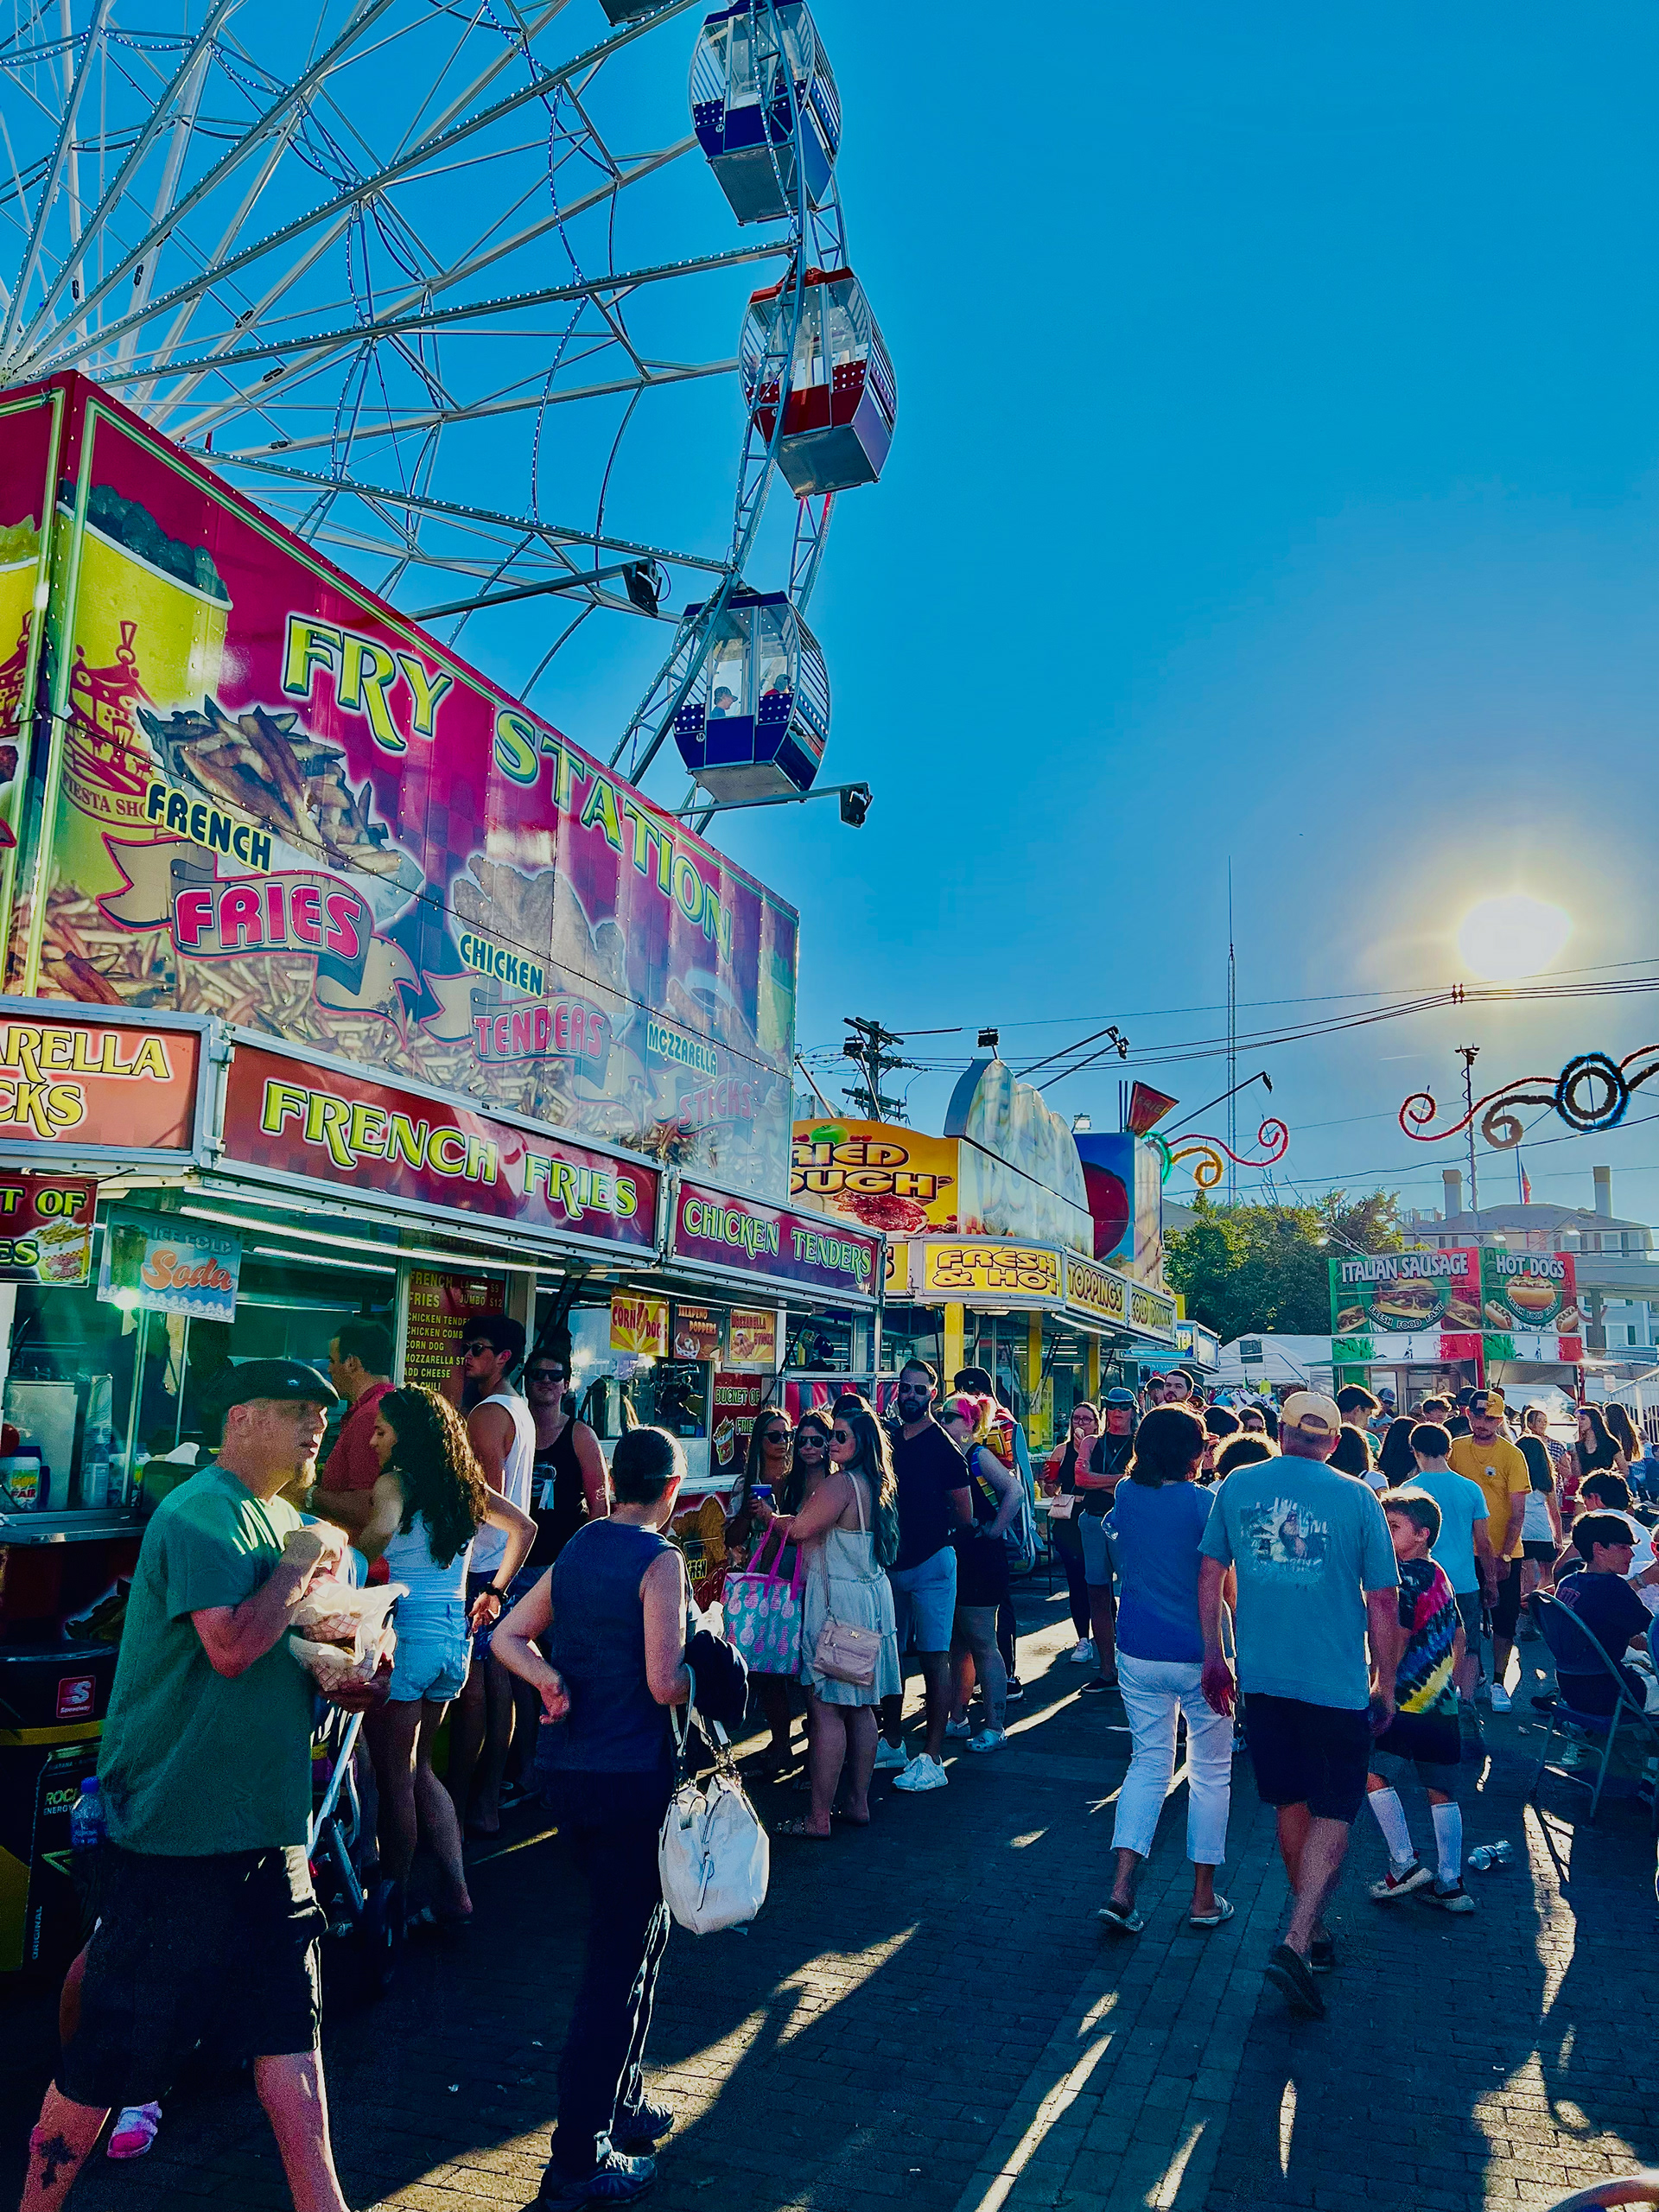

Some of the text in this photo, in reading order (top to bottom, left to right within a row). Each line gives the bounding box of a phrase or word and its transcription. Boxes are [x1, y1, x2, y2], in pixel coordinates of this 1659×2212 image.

[283, 615, 733, 964] FRY STATION
[146, 780, 274, 874] FRENCH
[175, 882, 363, 960] FRIES
[459, 932, 543, 998] CHICKEN
[474, 1002, 606, 1059] TENDERS
[648, 1022, 718, 1076] MOZZARELLA
[680, 1082, 754, 1128] STICKS
[262, 1079, 638, 1219] FRENCH FRIES
[792, 1141, 909, 1167] RIED
[35, 1189, 86, 1217] OF
[152, 1224, 233, 1255] ICE COLD
[684, 1199, 779, 1259] CHICKEN
[791, 1229, 871, 1283] TENDERS
[141, 1248, 233, 1292] Soda
[938, 1249, 1057, 1276] FRESH
[1341, 1252, 1469, 1283] ITALIAN SAUSAGE
[1497, 1253, 1566, 1279] HOT DOGS
[410, 1270, 453, 1288] FRENCH
[932, 1268, 1059, 1294] & HOT
[1068, 1262, 1122, 1313] TOPPINGS
[410, 1291, 440, 1308] FRIES
[408, 1313, 442, 1324] CHICKEN
[612, 1306, 636, 1329] CORN
[689, 1320, 717, 1335] POPPERS
[1368, 1300, 1445, 1329] FRESH FOOD FAST
[406, 1339, 444, 1351] CORN DOG
[407, 1325, 463, 1339] CHICKEN COMB
[421, 1368, 451, 1378] CHEESE
[715, 1387, 760, 1406] BUCKET OF
[735, 1417, 756, 1435] FRIE
[32, 1905, 42, 1960] ORIGINAL
